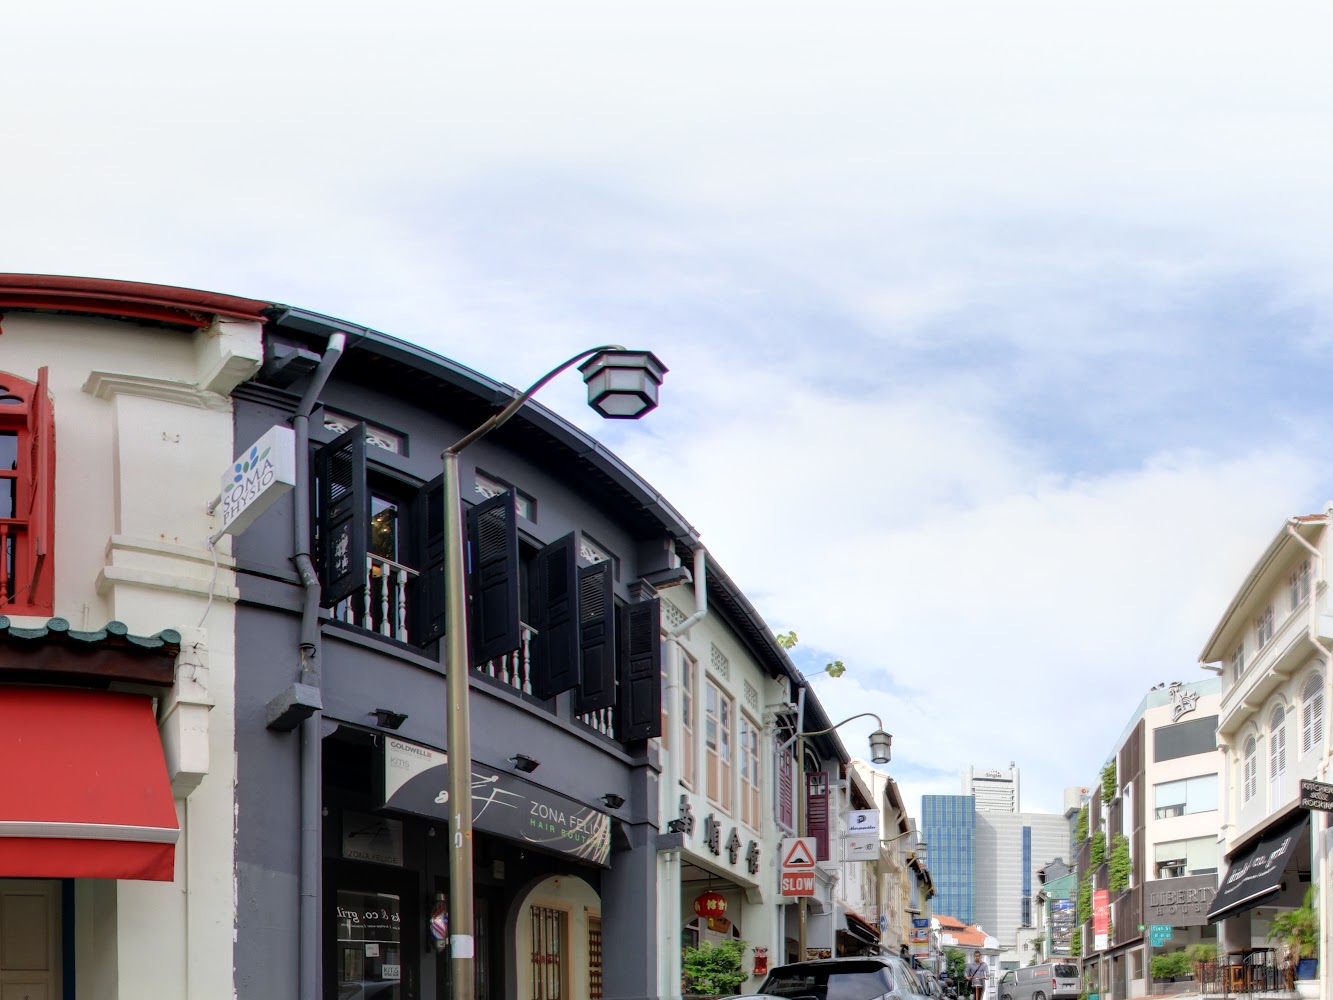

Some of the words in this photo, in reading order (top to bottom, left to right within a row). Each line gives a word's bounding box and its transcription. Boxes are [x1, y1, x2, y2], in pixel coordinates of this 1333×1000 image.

[223, 458, 274, 513] SOMA
[223, 470, 274, 526] PHYSIO
[390, 741, 428, 757] GOLDWELL
[530, 800, 567, 826] ZONA
[530, 818, 556, 834] HAIR
[782, 877, 814, 891] SLOW
